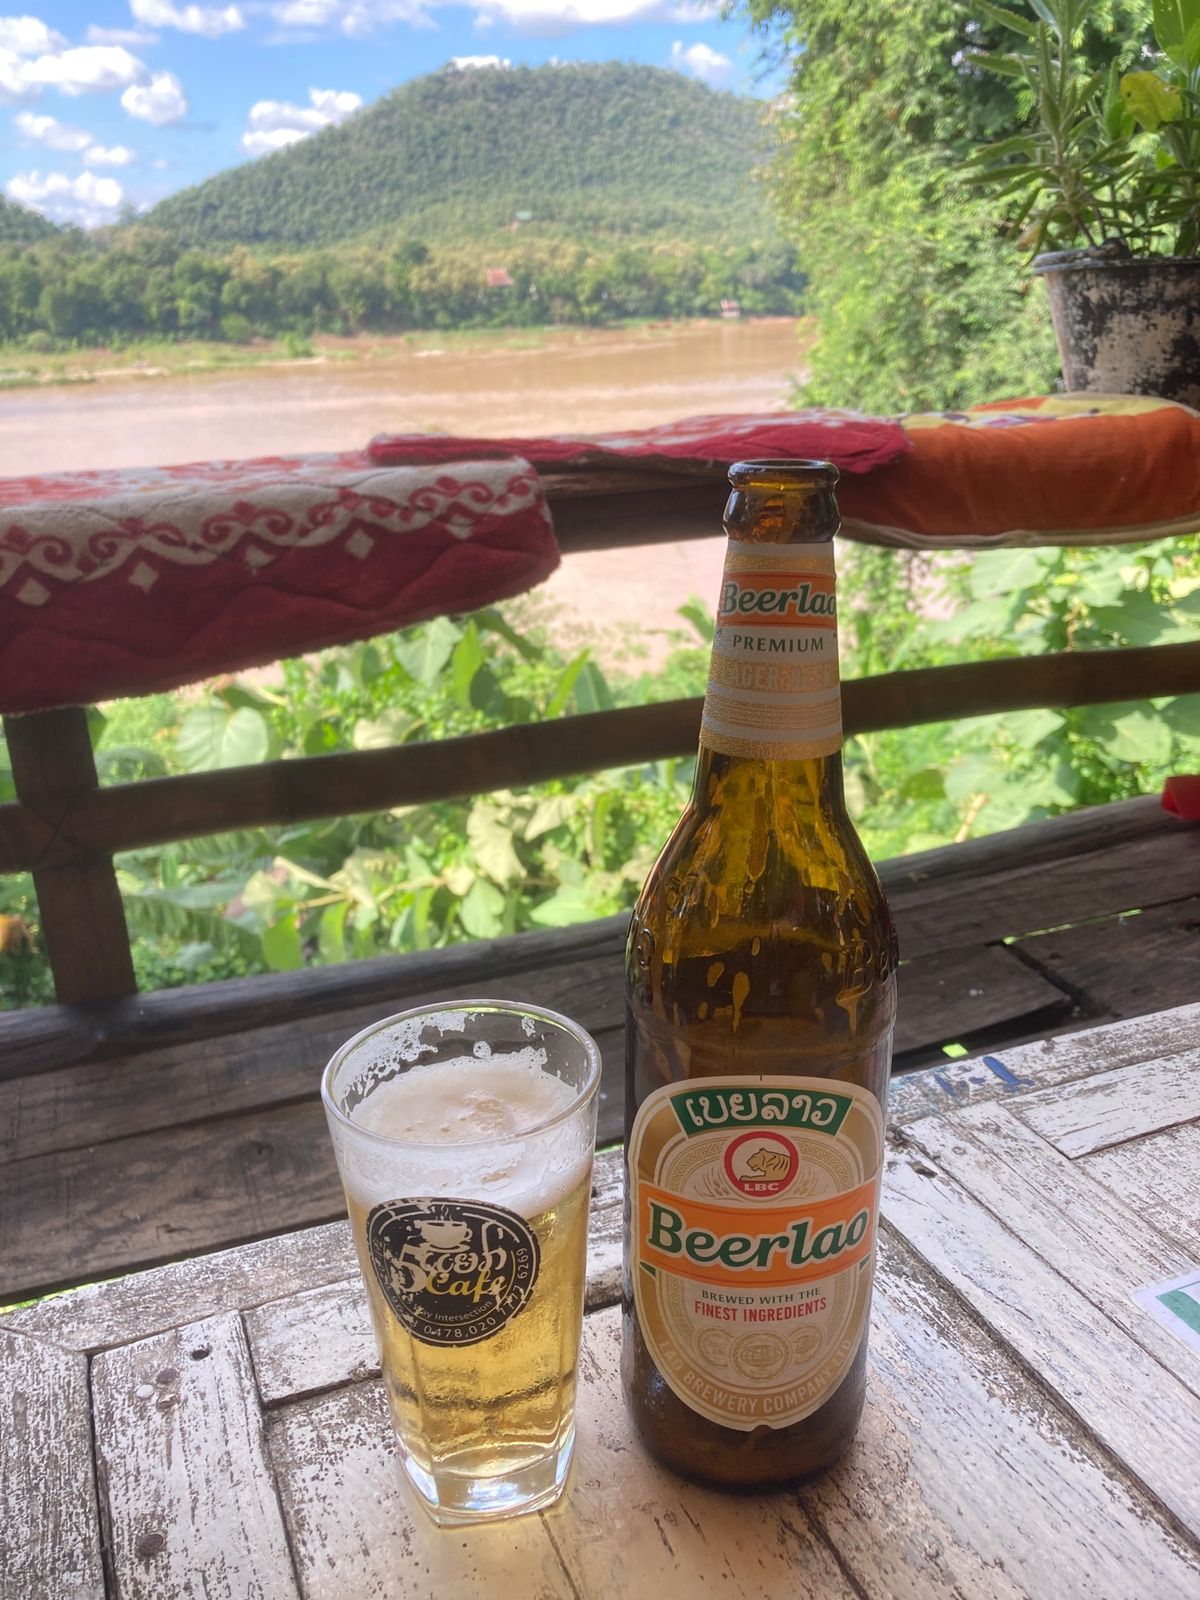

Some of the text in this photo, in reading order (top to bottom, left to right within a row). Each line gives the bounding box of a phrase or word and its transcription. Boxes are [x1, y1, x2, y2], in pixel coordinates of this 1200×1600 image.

[721, 581, 836, 616] Beerlao
[733, 634, 824, 653] PREMIUM
[685, 1092, 837, 1127] ເບຍລາວ
[743, 1182, 780, 1192] LBC
[647, 1200, 870, 1269] Beerlao
[516, 1247, 529, 1279] 6269
[694, 1297, 828, 1323] FINEST INGREDIENTS
[701, 1286, 821, 1305] BREWED WITH THE
[434, 1299, 493, 1322] Intersection
[658, 1339, 852, 1414] LAO BREWERY COMPANY LTD
